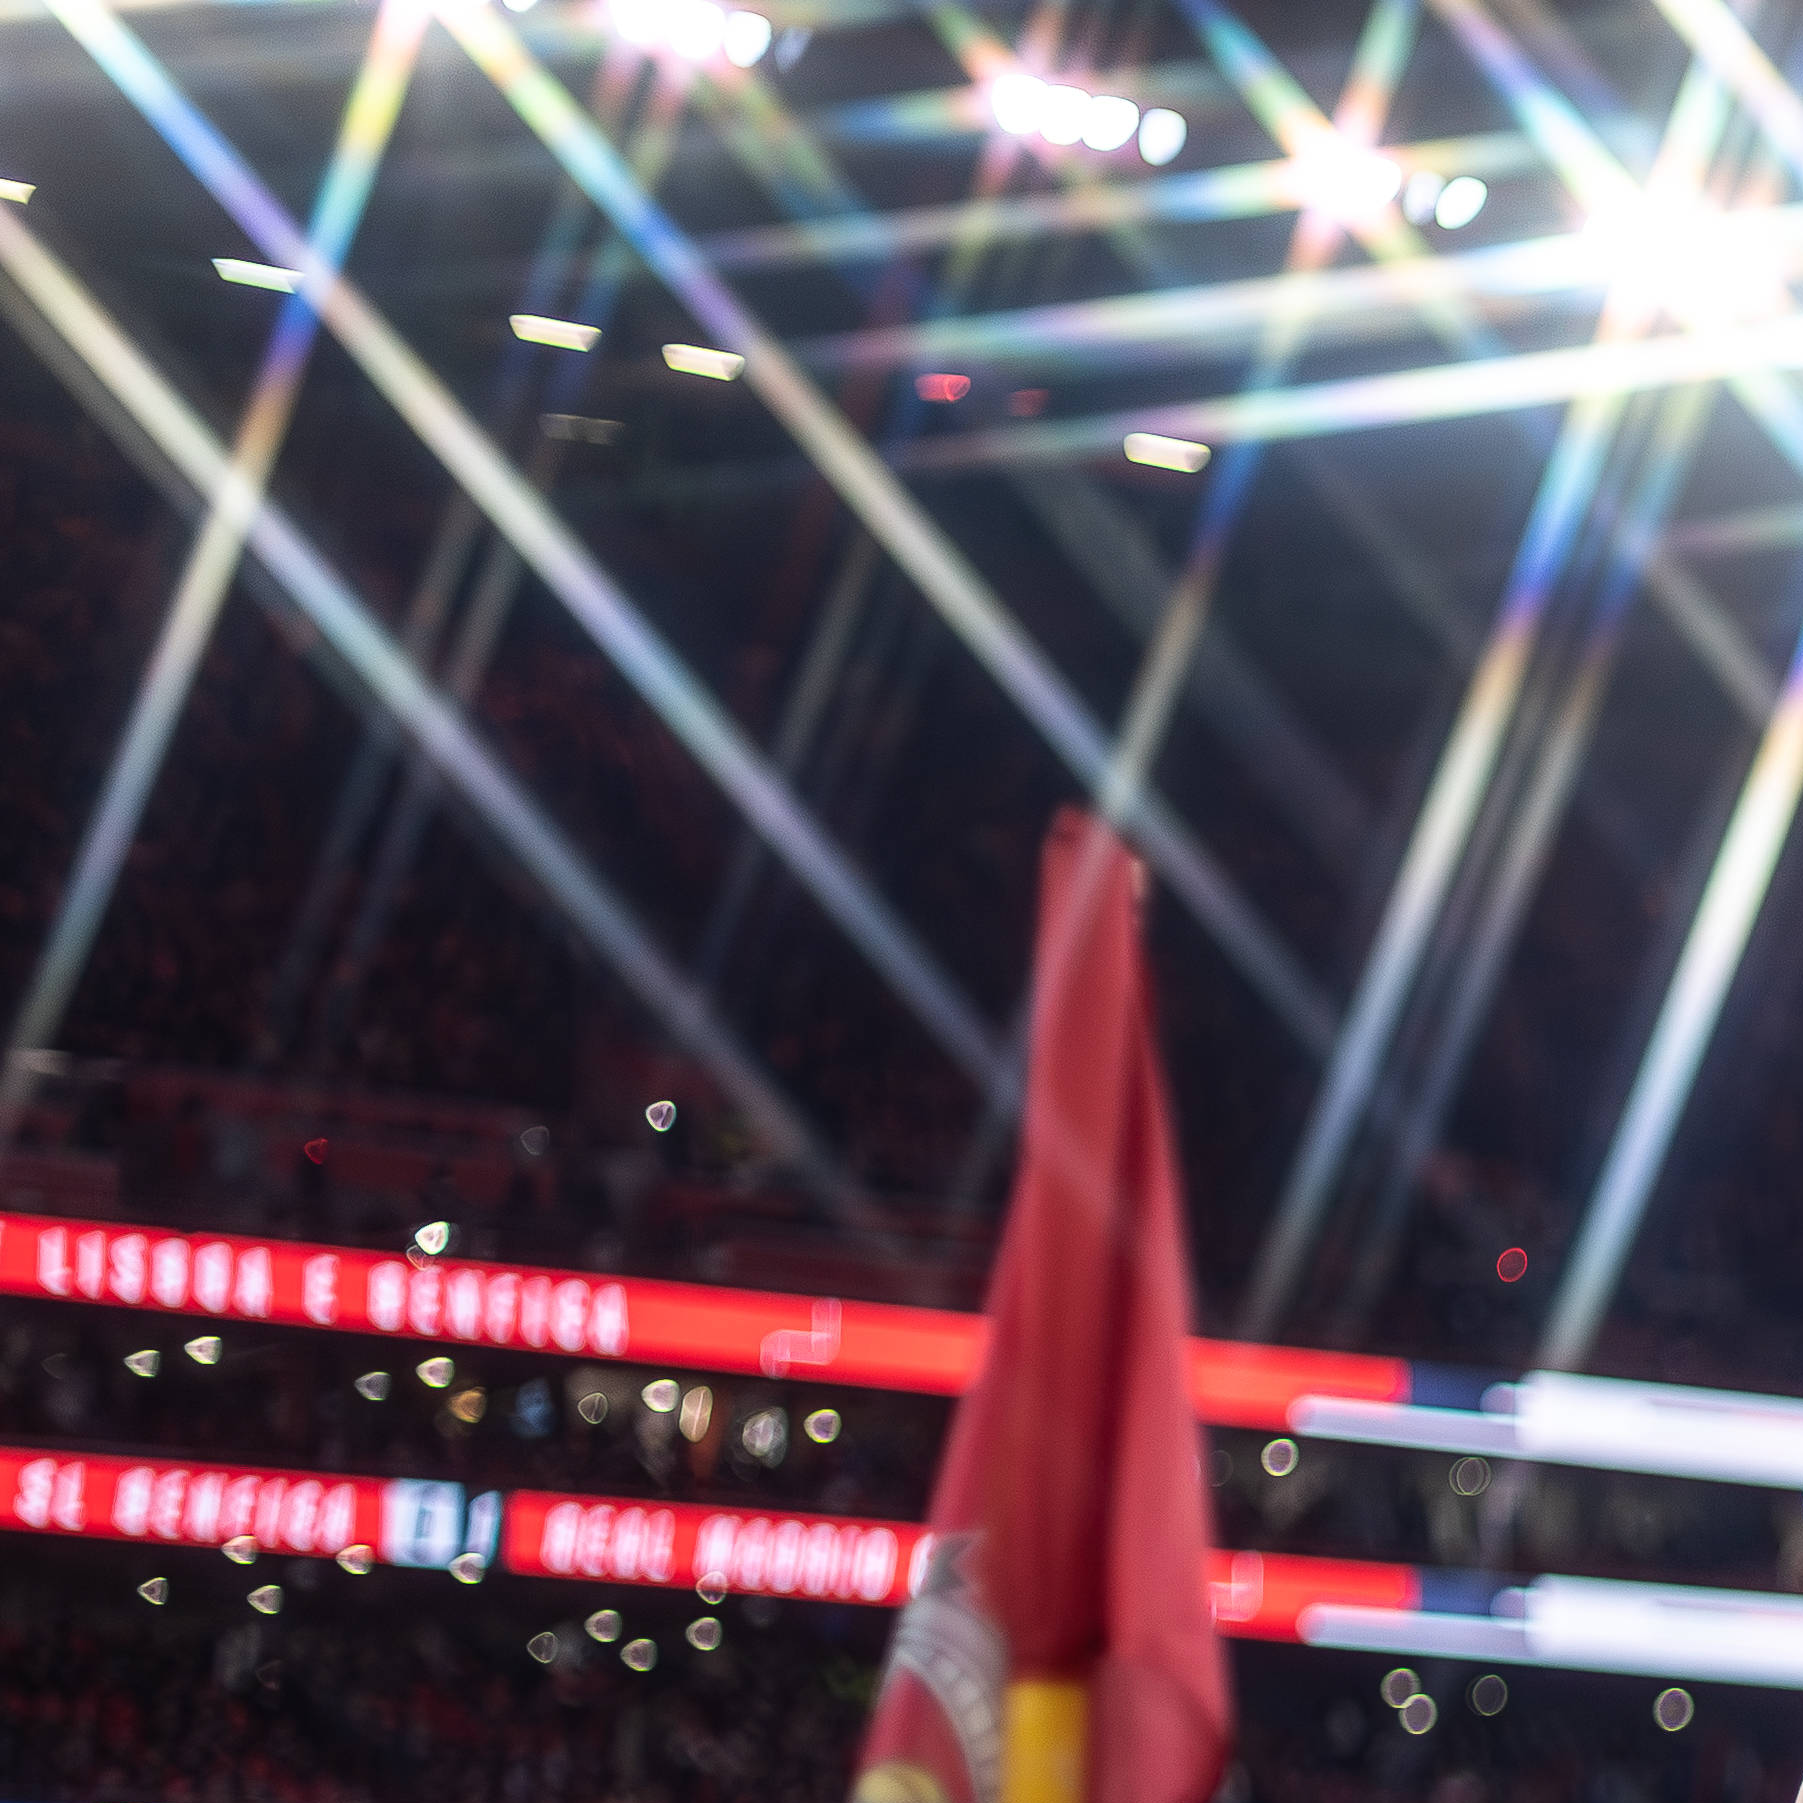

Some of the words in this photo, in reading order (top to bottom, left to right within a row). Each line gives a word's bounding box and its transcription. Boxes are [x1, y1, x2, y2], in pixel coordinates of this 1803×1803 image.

[36, 1225, 273, 1320] LISBOA
[302, 1252, 341, 1326] E
[366, 1259, 630, 1357] BENFICA
[13, 1457, 87, 1532] SL
[110, 1465, 357, 1555] BENFICA
